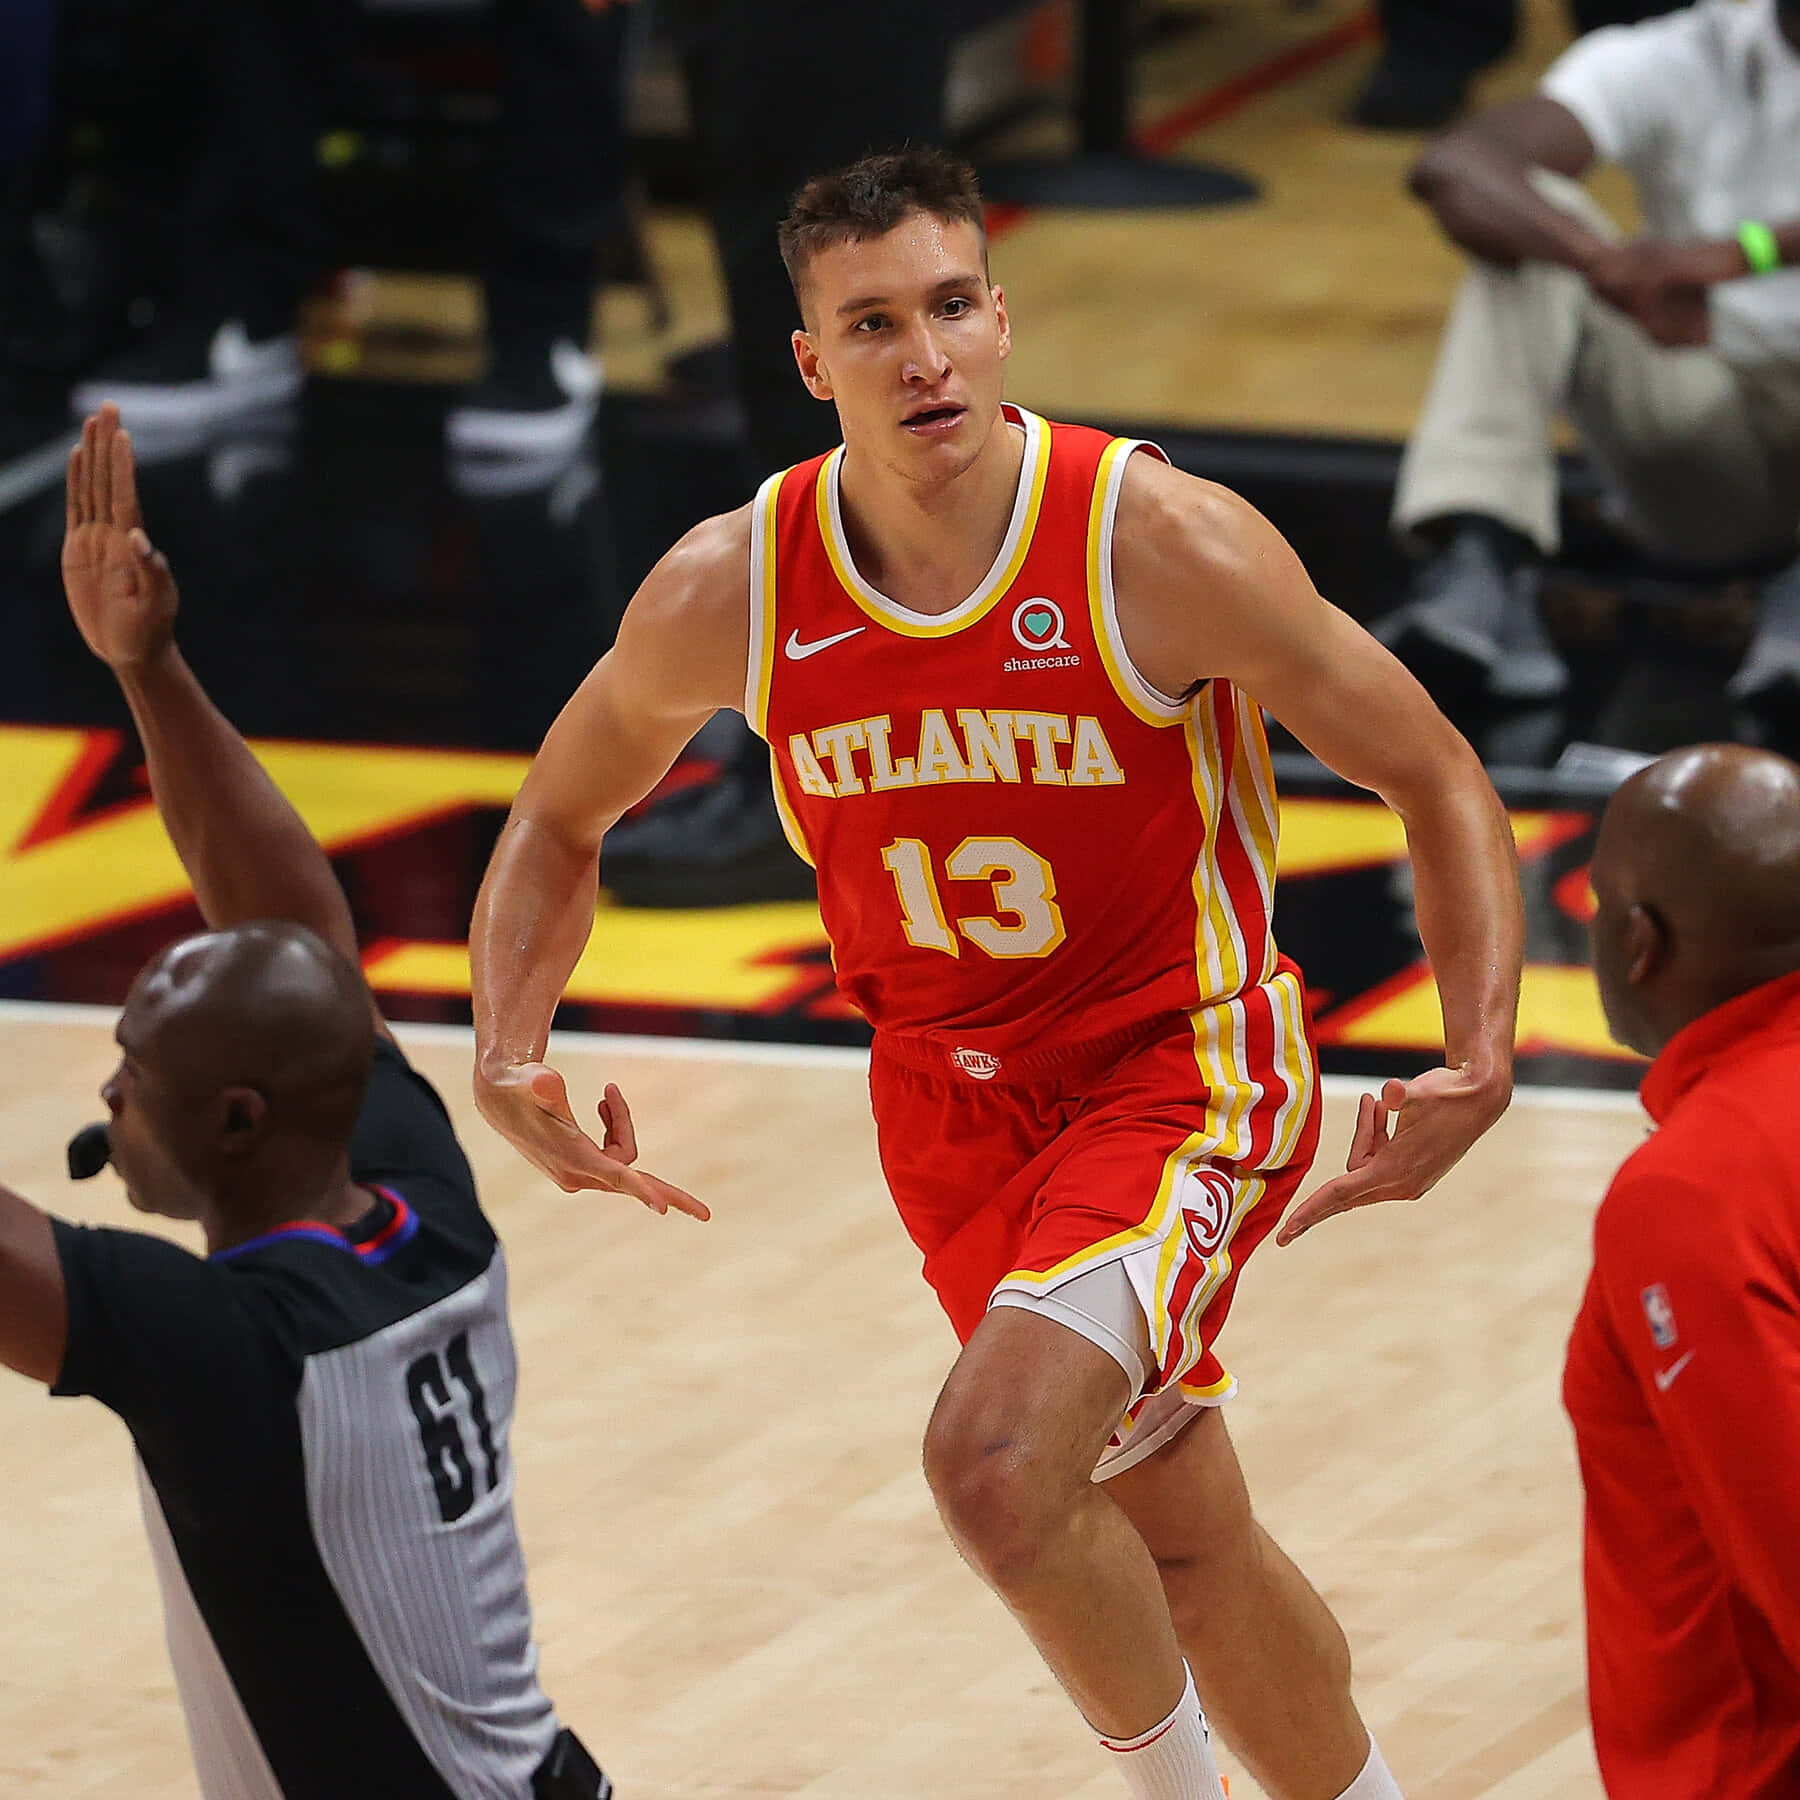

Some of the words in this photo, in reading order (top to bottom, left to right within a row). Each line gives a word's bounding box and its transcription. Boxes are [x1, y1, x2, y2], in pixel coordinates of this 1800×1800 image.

[1003, 655, 1080, 672] sharecare
[788, 708, 1125, 798] ATLANTA
[880, 836, 1067, 959] 13
[950, 1052, 1002, 1069] HAWKS
[405, 1329, 499, 1523] 61
